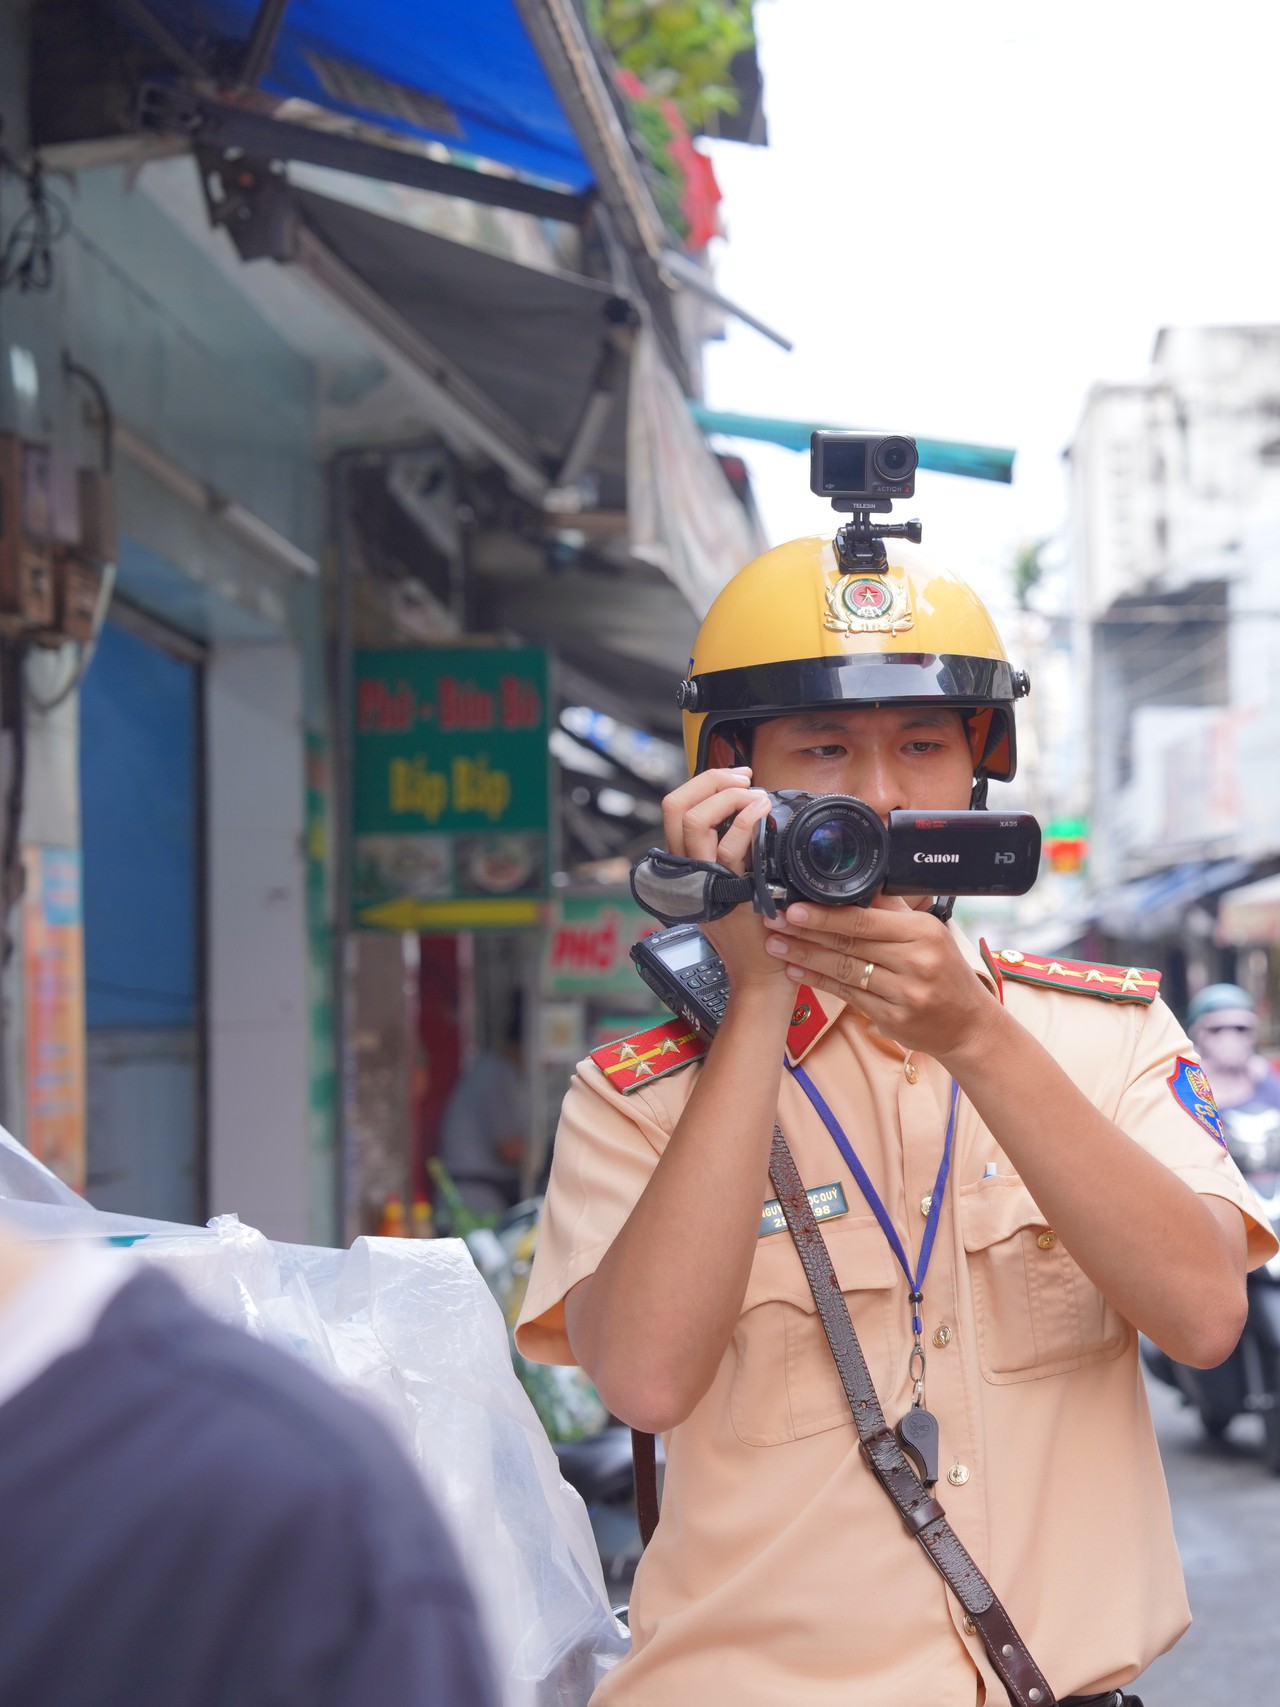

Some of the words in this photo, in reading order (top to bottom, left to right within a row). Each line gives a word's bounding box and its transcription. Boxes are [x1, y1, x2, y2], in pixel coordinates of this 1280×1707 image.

[805, 812, 824, 827] CANON
[999, 820, 1018, 828] XA35
[913, 852, 960, 864] Canon
[798, 860, 811, 879] OPTICAL
[809, 877, 825, 889] ZOOM
[660, 926, 694, 940] MOTOROLA
